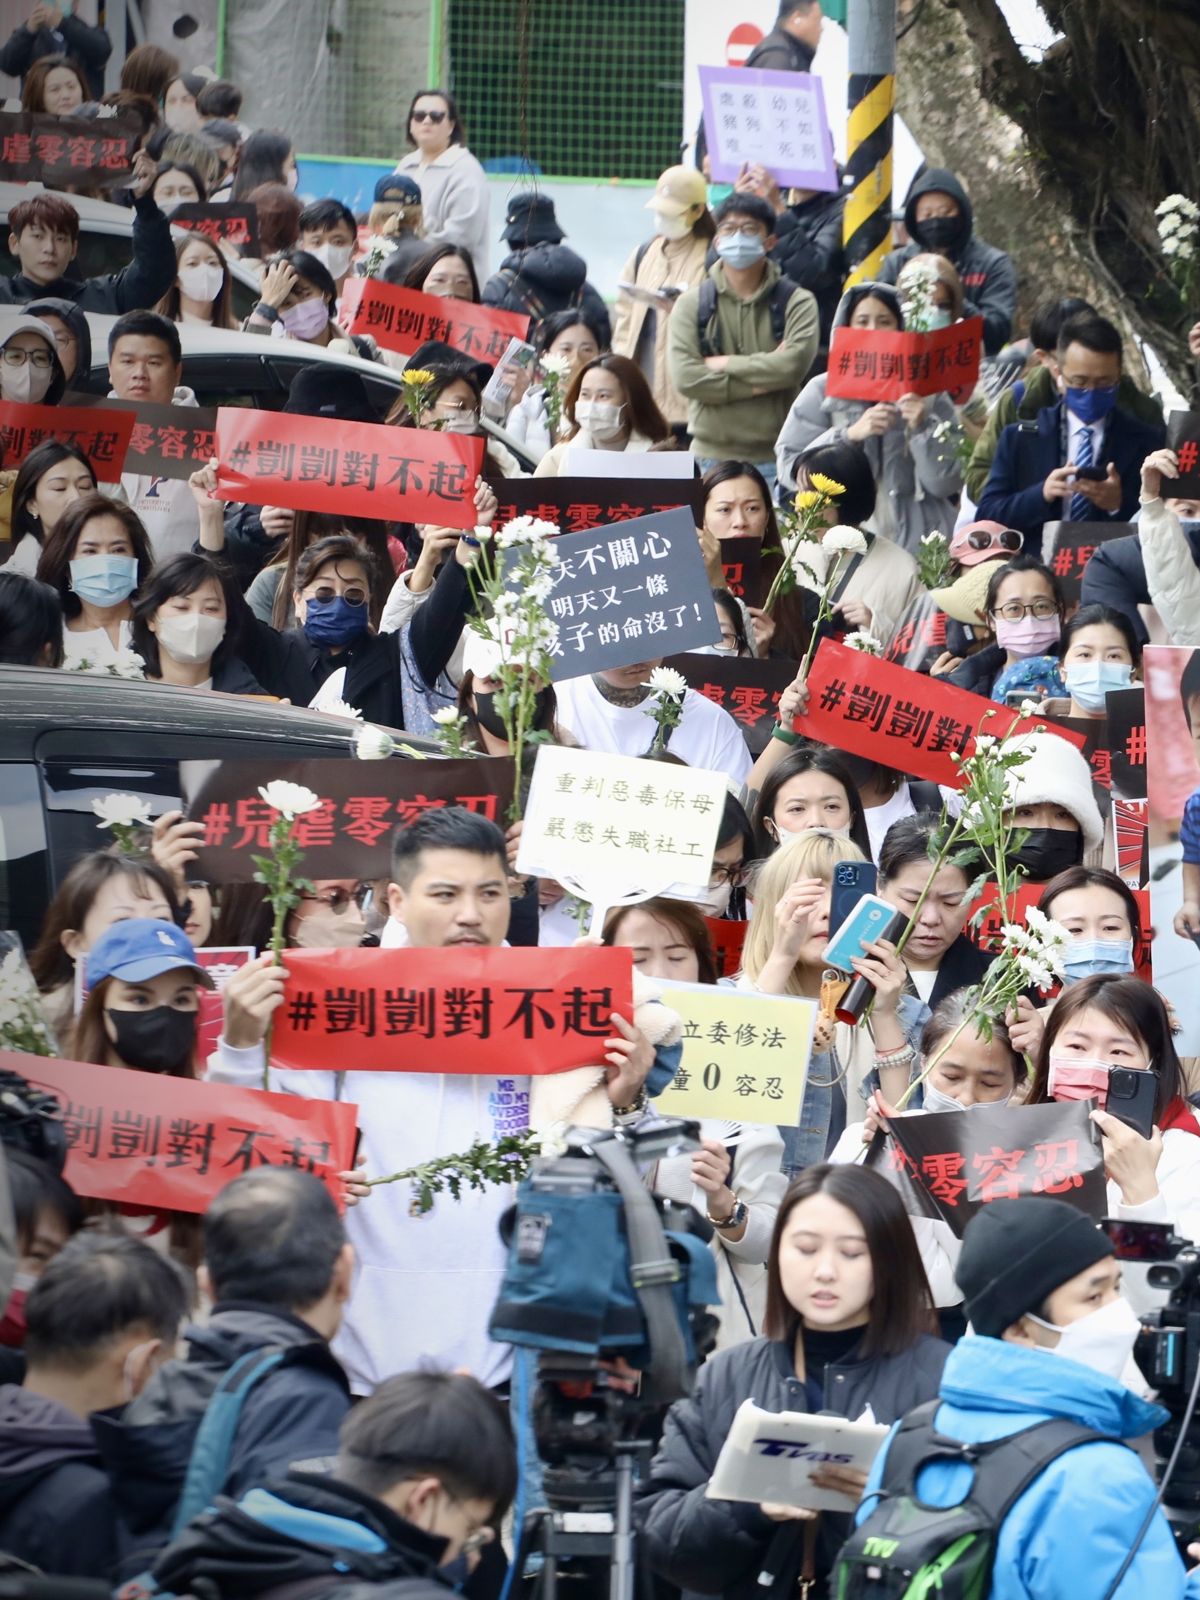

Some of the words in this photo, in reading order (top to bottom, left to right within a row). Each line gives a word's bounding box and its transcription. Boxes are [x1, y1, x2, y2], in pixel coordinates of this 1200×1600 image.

[229, 438, 468, 502] #剴剴對不起
[551, 574, 670, 619] 明天又一條
[554, 772, 715, 814] 重判惡毒保母
[544, 817, 704, 858] 嚴懲失職社工
[287, 986, 613, 1039] #剴剴對不起
[681, 1019, 787, 1049] 立委修法
